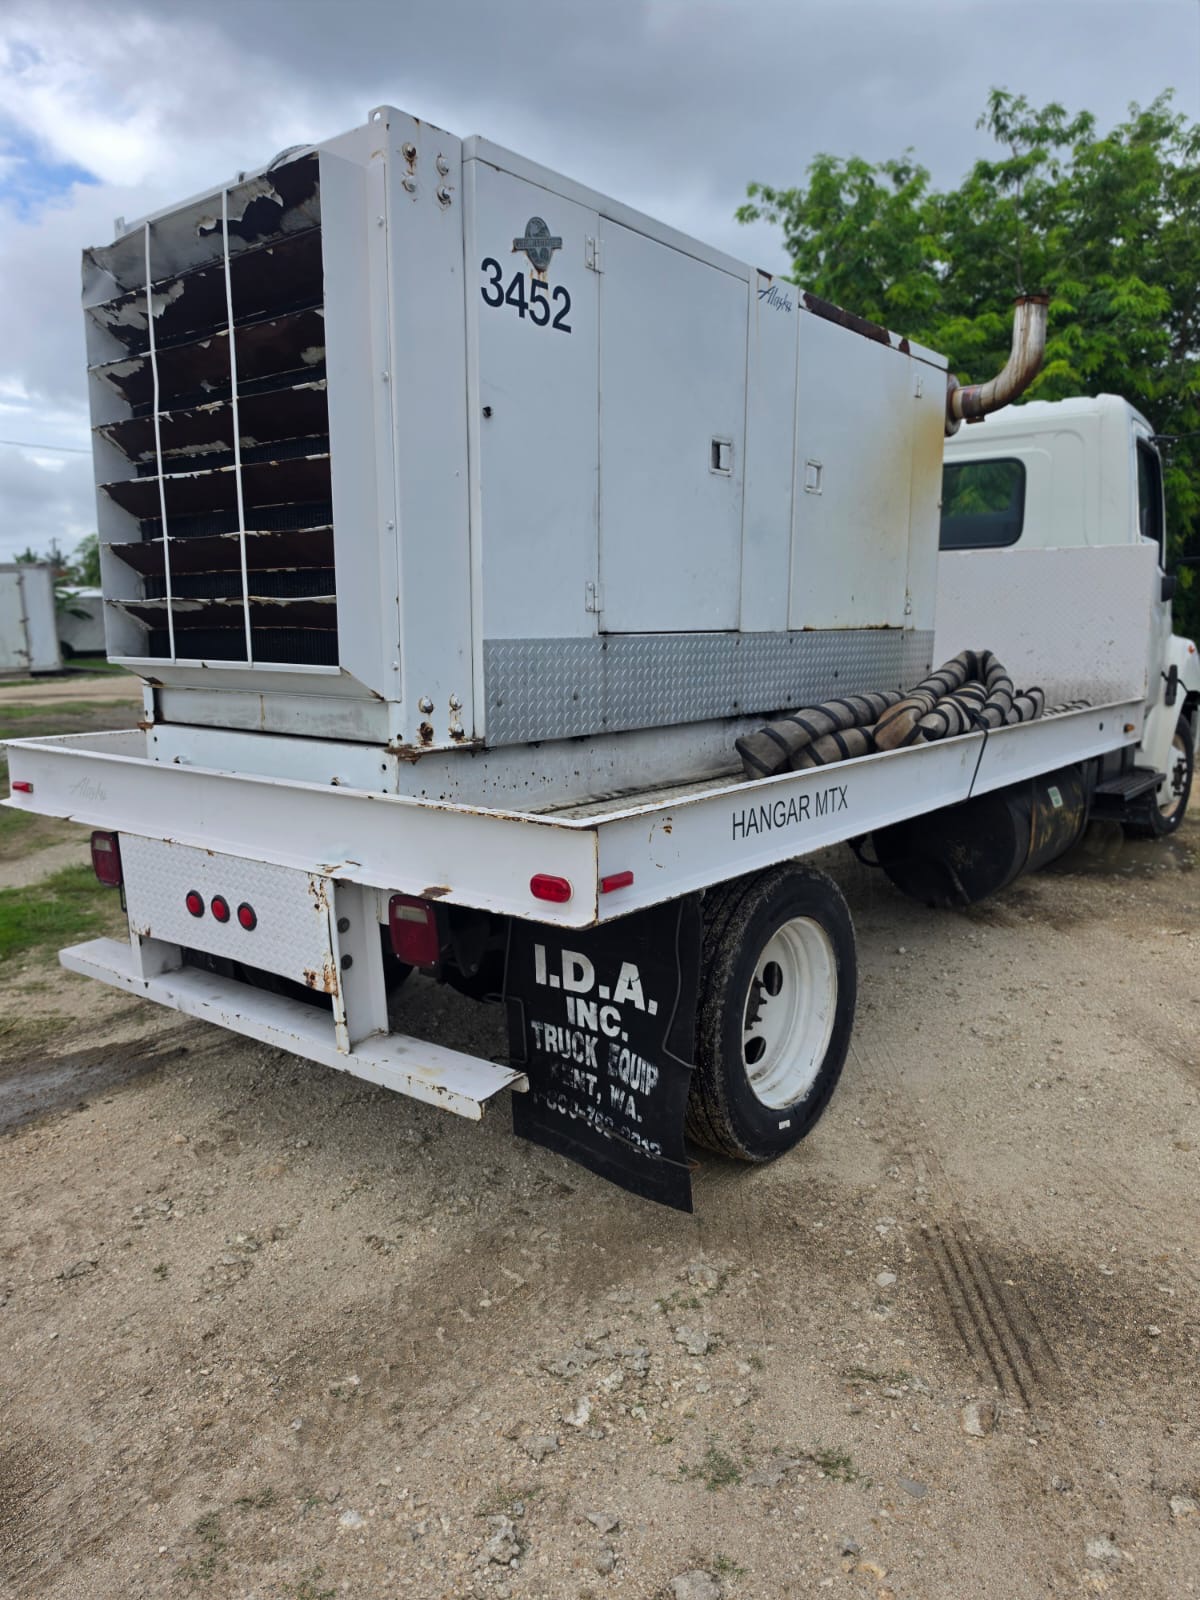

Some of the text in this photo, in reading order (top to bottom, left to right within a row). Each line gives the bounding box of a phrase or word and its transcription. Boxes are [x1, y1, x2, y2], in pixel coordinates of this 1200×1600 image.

[481, 257, 572, 334] 3452
[757, 285, 793, 312] Alaska
[732, 784, 848, 840] HANGAR MTX
[534, 943, 658, 1016] I.D.A.
[566, 996, 629, 1042] INC.
[531, 1019, 660, 1096] TRUCK EQUIP
[610, 1084, 643, 1123] WA.
